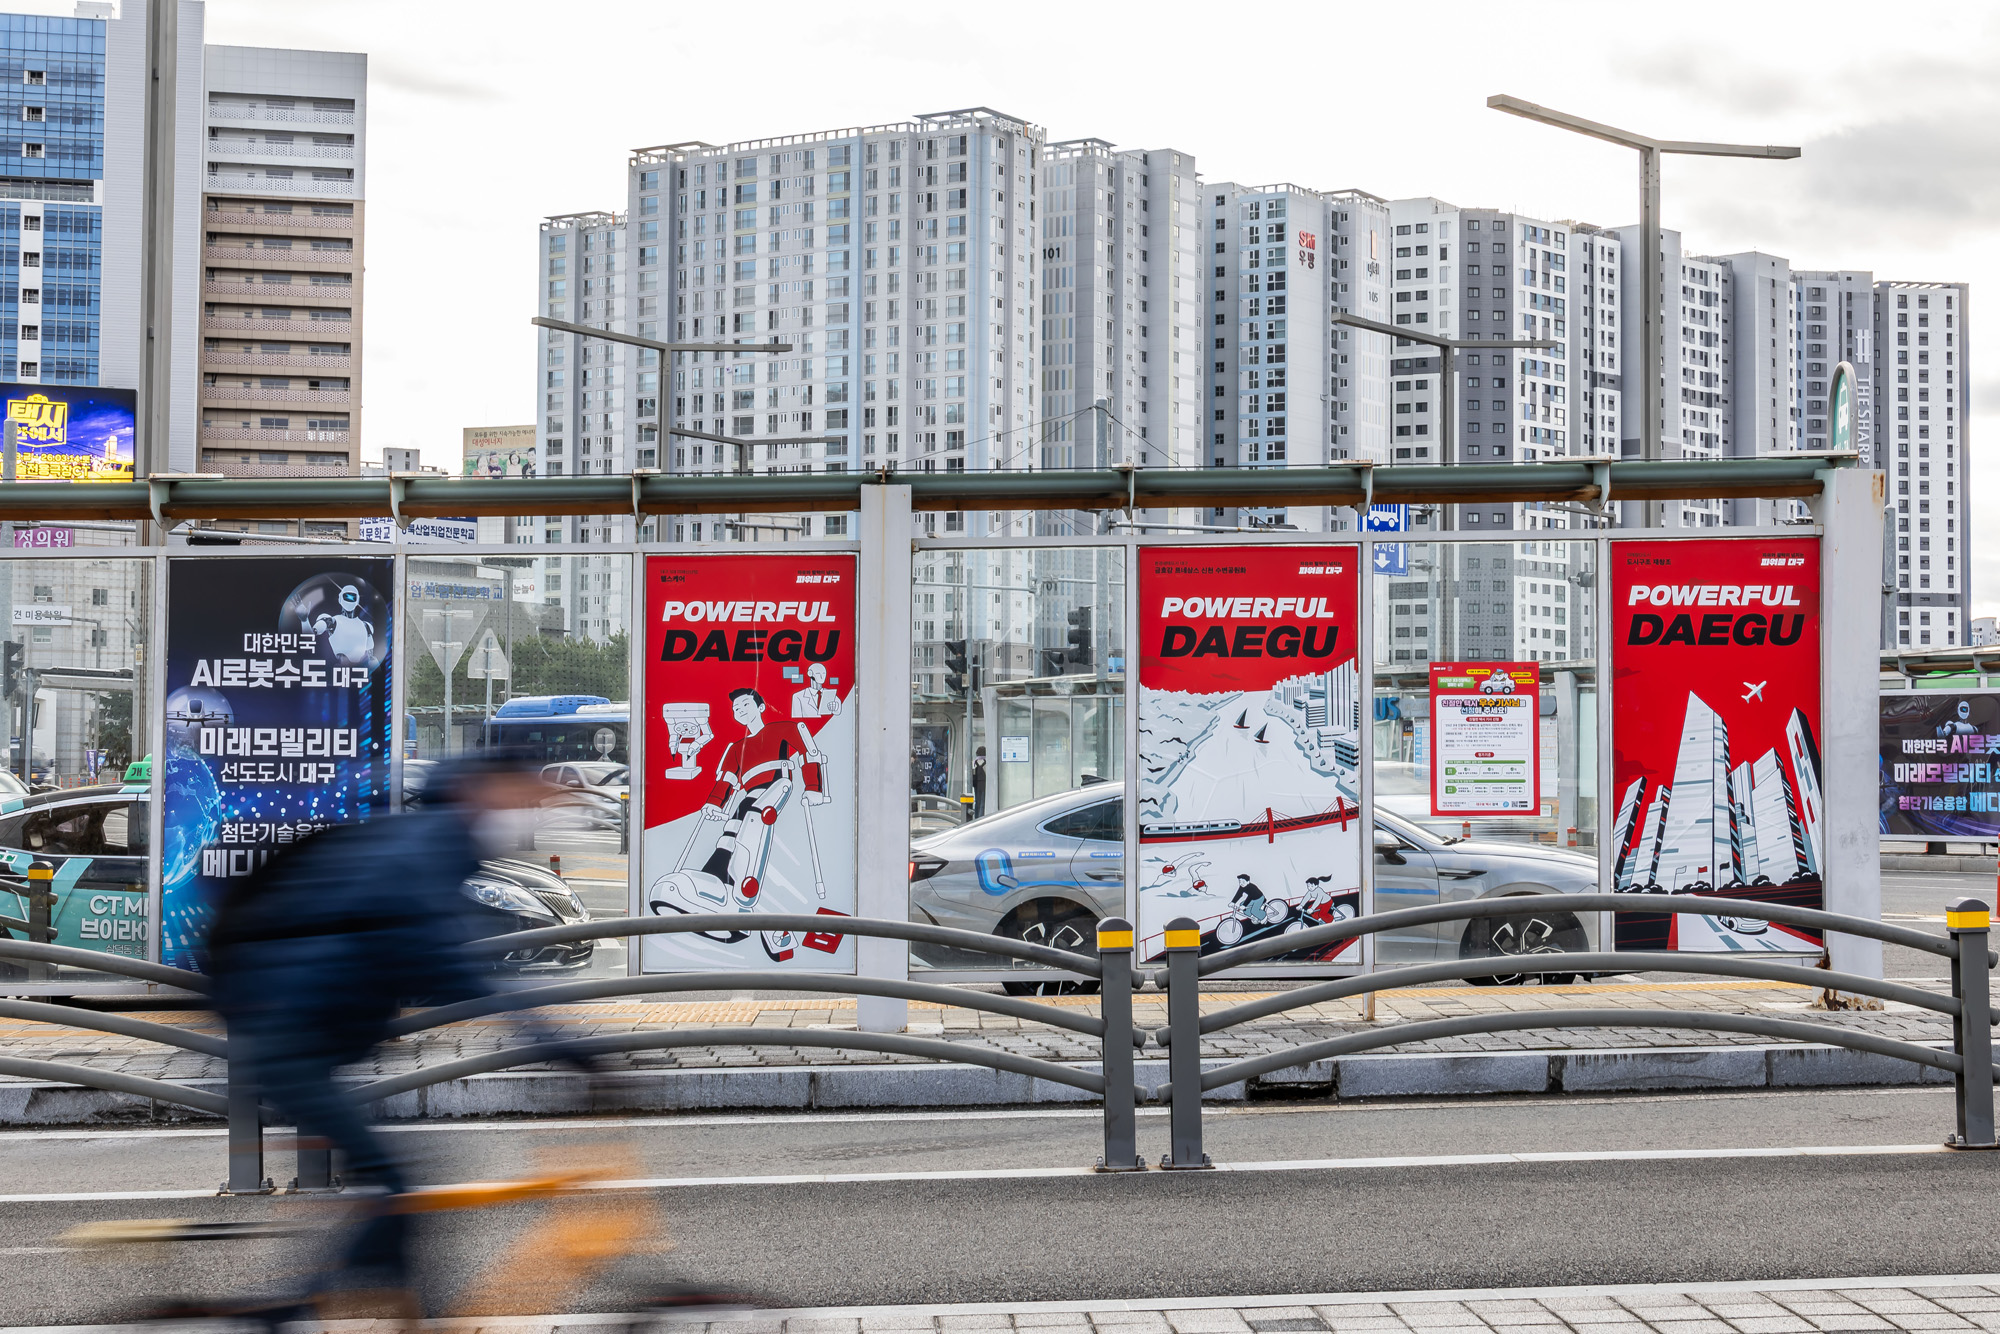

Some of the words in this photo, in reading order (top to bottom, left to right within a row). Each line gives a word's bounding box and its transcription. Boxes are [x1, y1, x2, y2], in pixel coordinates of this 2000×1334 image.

[1042, 247, 1060, 260] 101
[10, 402, 65, 428] 택시
[472, 437, 503, 447] 대성에너지
[1325, 566, 1343, 575] 대구
[1787, 558, 1805, 566] 대구
[823, 575, 841, 583] 대구
[1629, 585, 1801, 606] POWERFUL
[662, 601, 836, 622] POWERFUL
[1161, 597, 1335, 618] POWERFUL
[1627, 613, 1805, 646] DAEGU
[243, 633, 317, 654] 대한민국
[660, 630, 841, 662] DAEGU
[1160, 625, 1339, 658] DAEGU
[190, 659, 328, 688] AI로봇수도
[332, 667, 369, 689] 대구
[1478, 698, 1496, 707] 우수
[200, 728, 358, 758] 미래모빌리티
[1902, 739, 1948, 754] 대한민국
[220, 762, 297, 783] 선도도시
[299, 762, 335, 783] 대구
[1894, 763, 1991, 784] 미래모빌리티
[1899, 795, 1967, 811] 첨단기술융합
[221, 823, 331, 844] 첨단기술융
